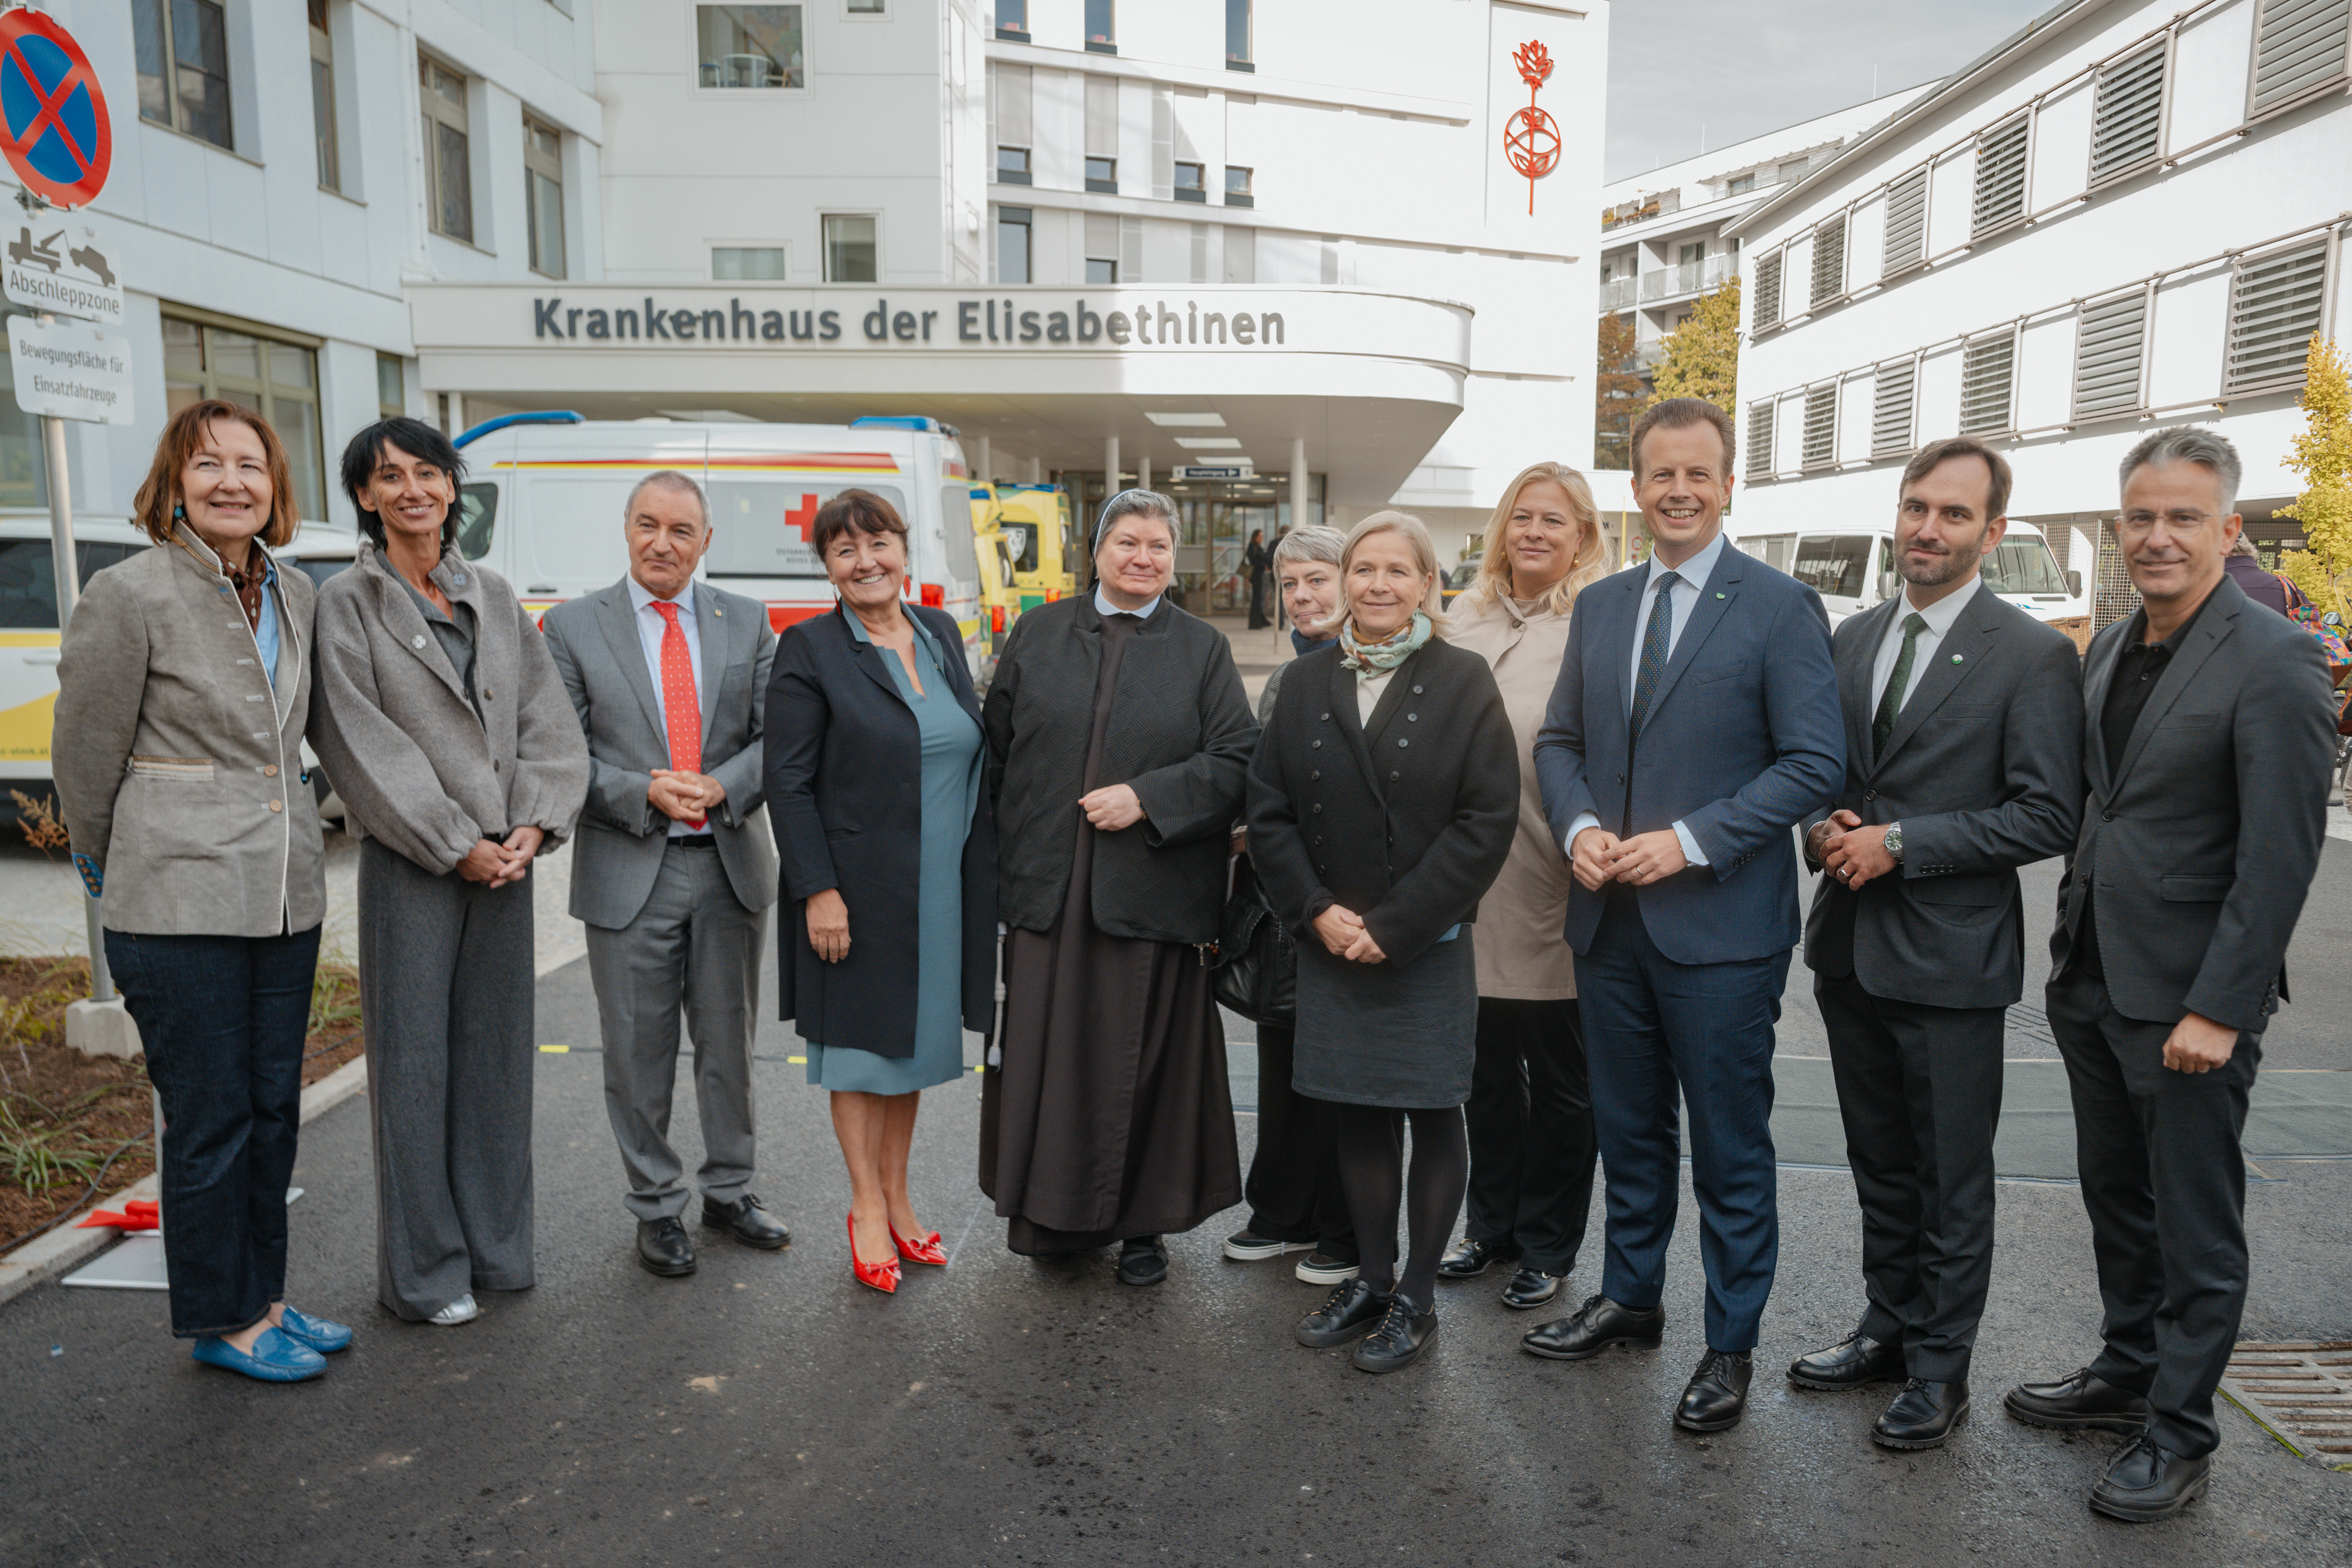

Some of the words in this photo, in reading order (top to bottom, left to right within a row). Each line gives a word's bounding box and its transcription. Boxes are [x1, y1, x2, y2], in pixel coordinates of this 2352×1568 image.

[10, 270, 119, 314] Abschleppzone
[534, 297, 841, 341] Krankenhaus
[863, 299, 937, 341] der
[958, 299, 1285, 345] Elisabethinen
[20, 339, 107, 370] Bewegungsfläche
[110, 356, 123, 374] für
[34, 374, 117, 406] Einsatzfahrzeuge
